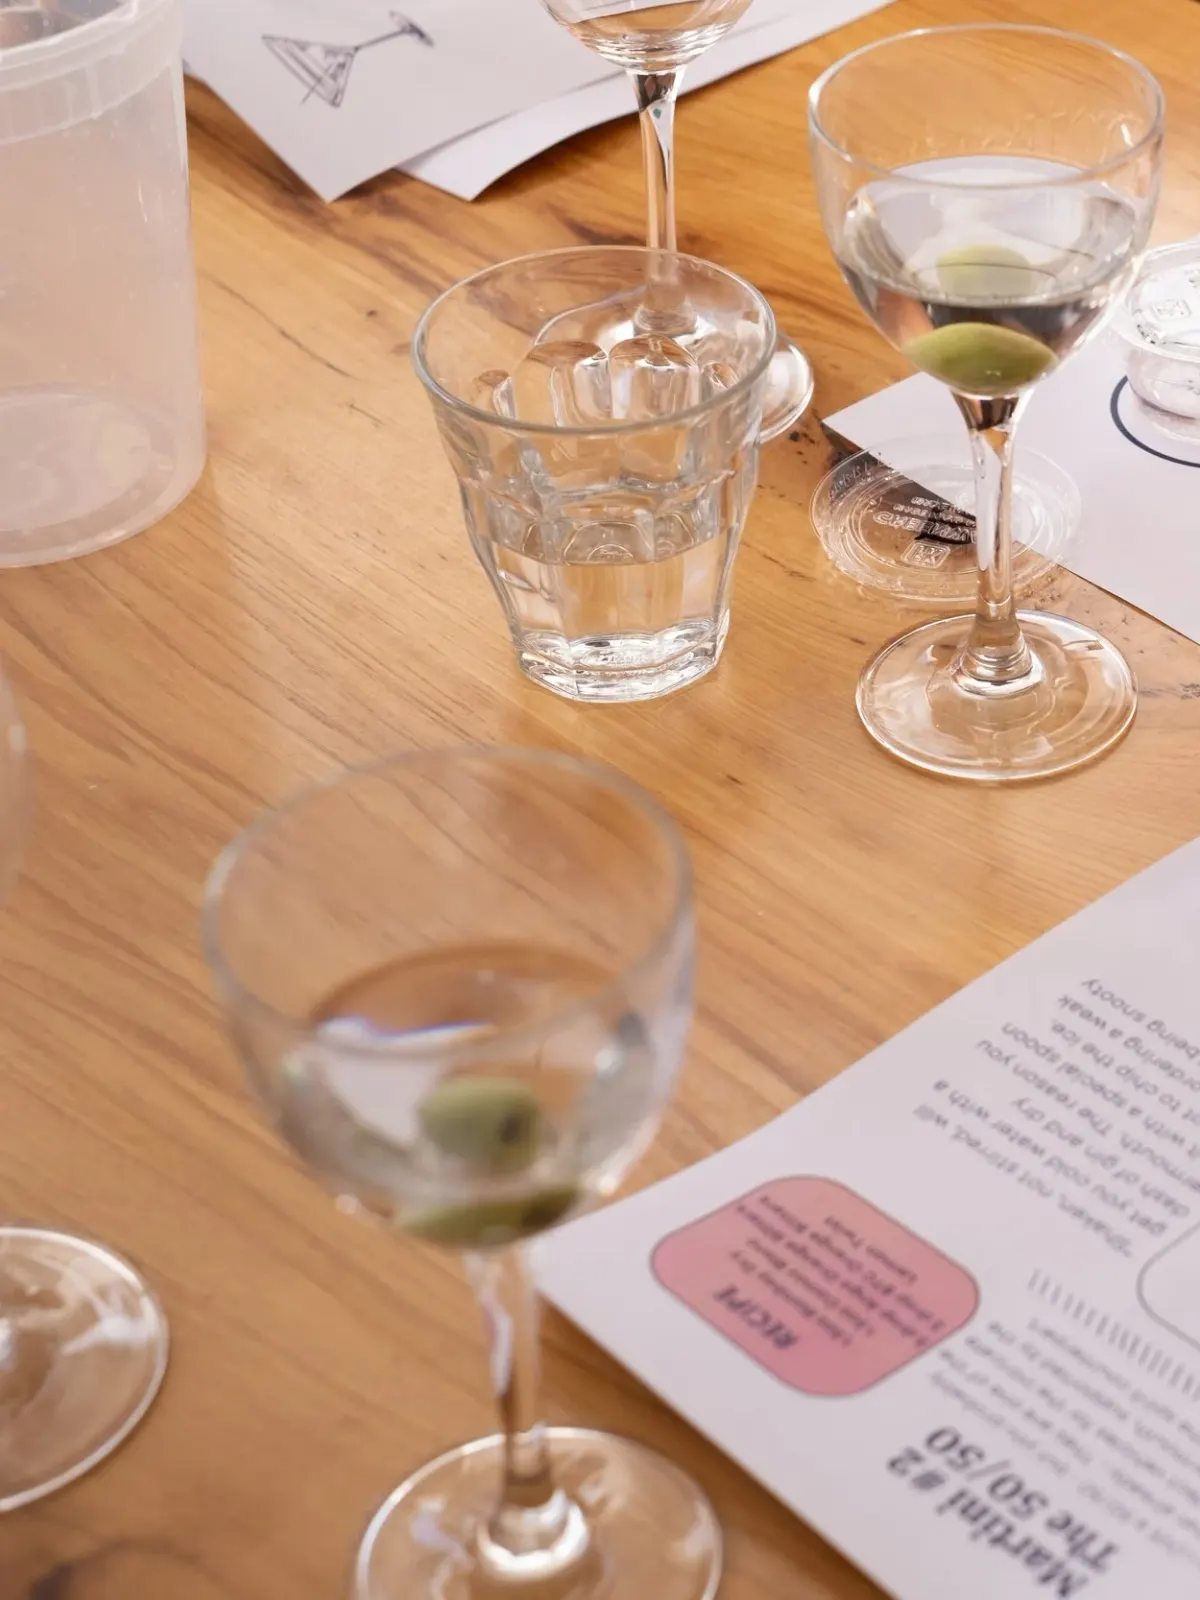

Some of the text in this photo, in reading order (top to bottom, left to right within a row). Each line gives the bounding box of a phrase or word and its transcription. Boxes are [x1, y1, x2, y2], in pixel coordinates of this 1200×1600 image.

[1057, 994, 1107, 1030] weak
[1080, 978, 1147, 1023] snooty
[1000, 1022, 1061, 1063] spoon
[1050, 1018, 1081, 1047] ice.
[1107, 1027, 1124, 1039] a
[1145, 1018, 1200, 1060] being
[975, 1039, 1016, 1066] you
[1080, 1042, 1114, 1068] the
[932, 1079, 949, 1091] a
[1011, 1063, 1077, 1109] reason
[1056, 1061, 1128, 1108] special
[1114, 1064, 1159, 1095] chip
[947, 1089, 990, 1120] with
[1010, 1096, 1045, 1122] dry
[1127, 1105, 1143, 1116] a
[1157, 1092, 1181, 1113] to
[1041, 1119, 1084, 1147] and
[1076, 1106, 1112, 1137] The
[1142, 1115, 1186, 1147] with
[989, 1120, 1046, 1157] water
[1083, 1144, 1120, 1170] gin
[1110, 1168, 1140, 1186] of
[1090, 1183, 1133, 1211] you
[712, 1284, 798, 1349] RECIPE
[924, 1426, 1119, 1576] The 50/50
[936, 1490, 1087, 1600] Martini
